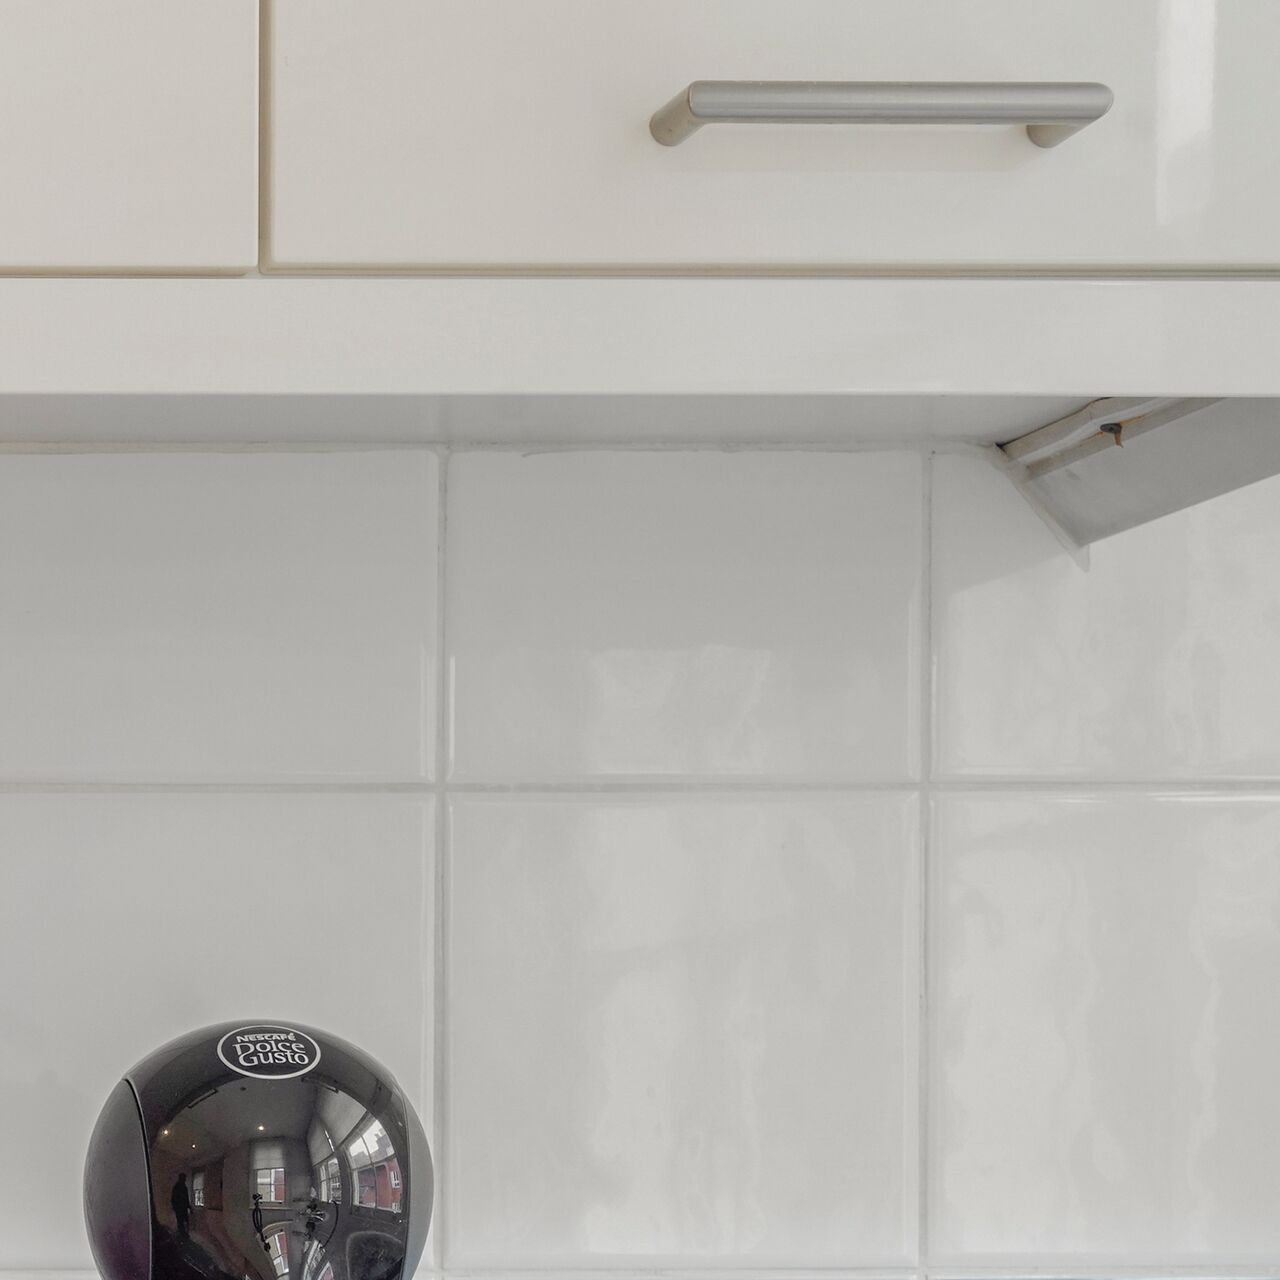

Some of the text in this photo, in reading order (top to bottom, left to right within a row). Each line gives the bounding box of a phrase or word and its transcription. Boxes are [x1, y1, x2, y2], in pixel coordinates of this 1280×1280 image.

[236, 1032, 296, 1042] NESCAFÉ
[232, 1041, 306, 1056] Dolce
[238, 1051, 309, 1067] Gusto
